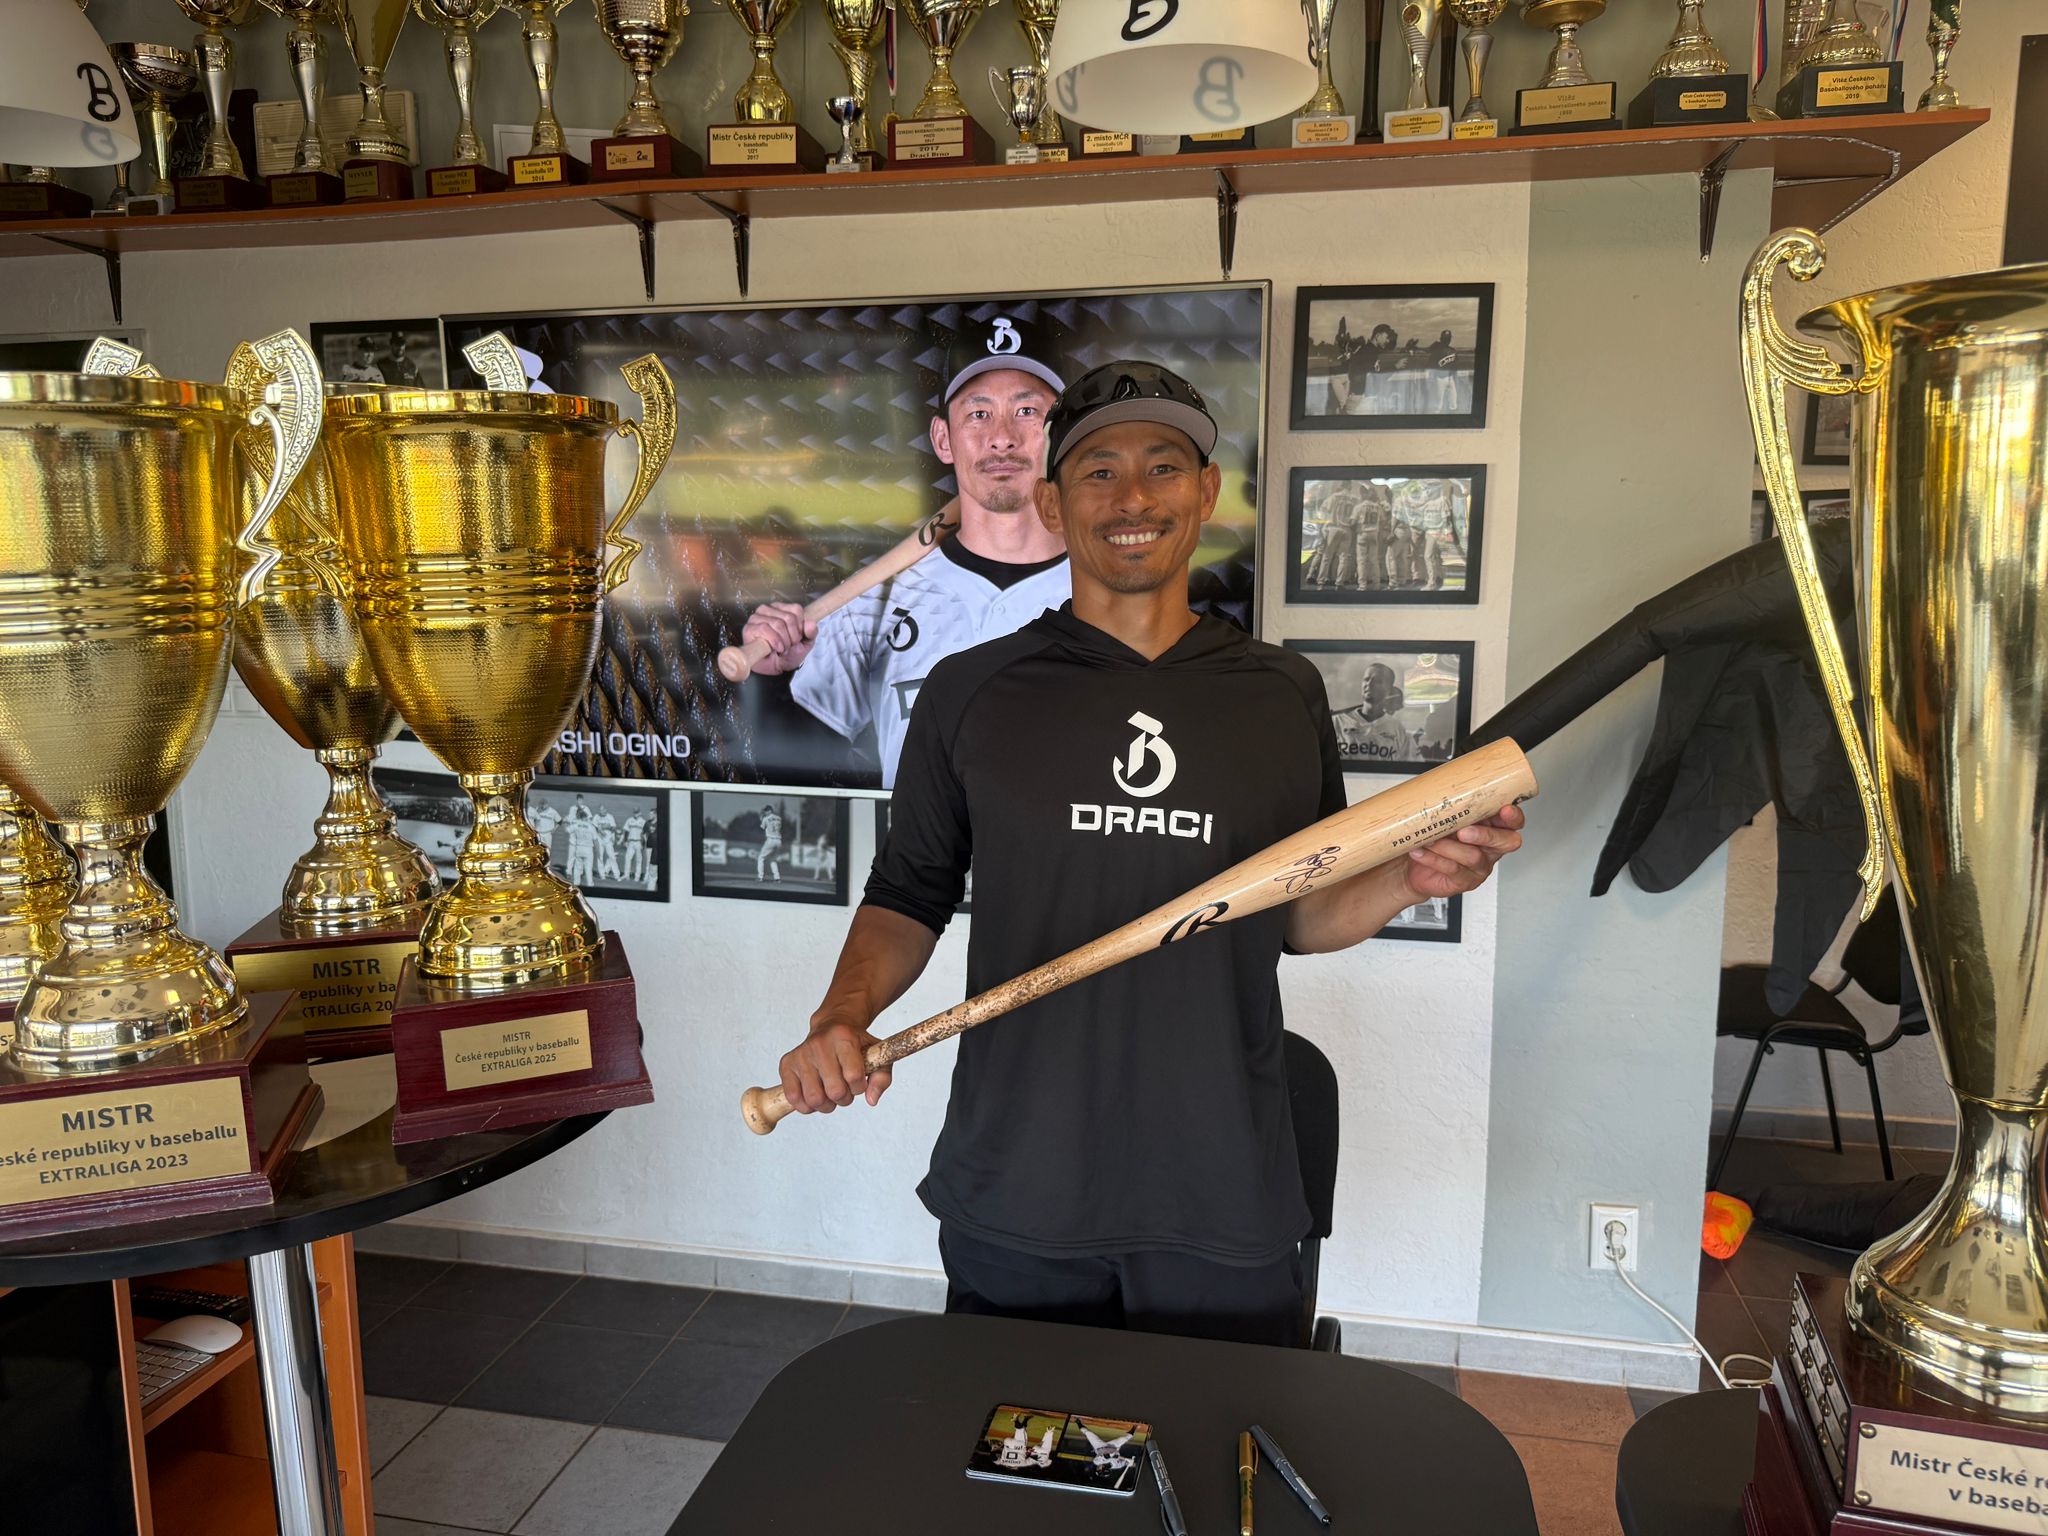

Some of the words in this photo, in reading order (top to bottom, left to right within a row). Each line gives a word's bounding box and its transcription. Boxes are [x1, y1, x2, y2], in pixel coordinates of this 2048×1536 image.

[712, 133, 731, 141] Mistr
[732, 132, 757, 141] České
[758, 132, 794, 141] republiky
[608, 733, 691, 758] OGINO
[1337, 741, 1396, 759] Reebok
[1069, 803, 1213, 845] DRACI
[1392, 835, 1412, 848] PRO
[1414, 808, 1471, 837] PREFERRED
[313, 958, 381, 980] MISTR
[367, 984, 375, 993] v
[502, 1031, 531, 1043] MISTR
[455, 1050, 482, 1064] České
[483, 1045, 527, 1060] republiky
[529, 1044, 535, 1052] v
[536, 1037, 580, 1051] baseballu
[481, 1057, 532, 1073] EXTRALIGA
[534, 1053, 557, 1064] 2025
[61, 1103, 155, 1133] MISTR
[42, 1139, 131, 1162] republiky
[135, 1138, 146, 1149] v
[150, 1125, 238, 1148] baseballu
[39, 1159, 142, 1185] EXTRALIGA
[146, 1153, 189, 1171] 2023
[1890, 1449, 1951, 1474] Mistr
[1957, 1457, 2028, 1487] České
[1949, 1488, 1962, 1501] v
